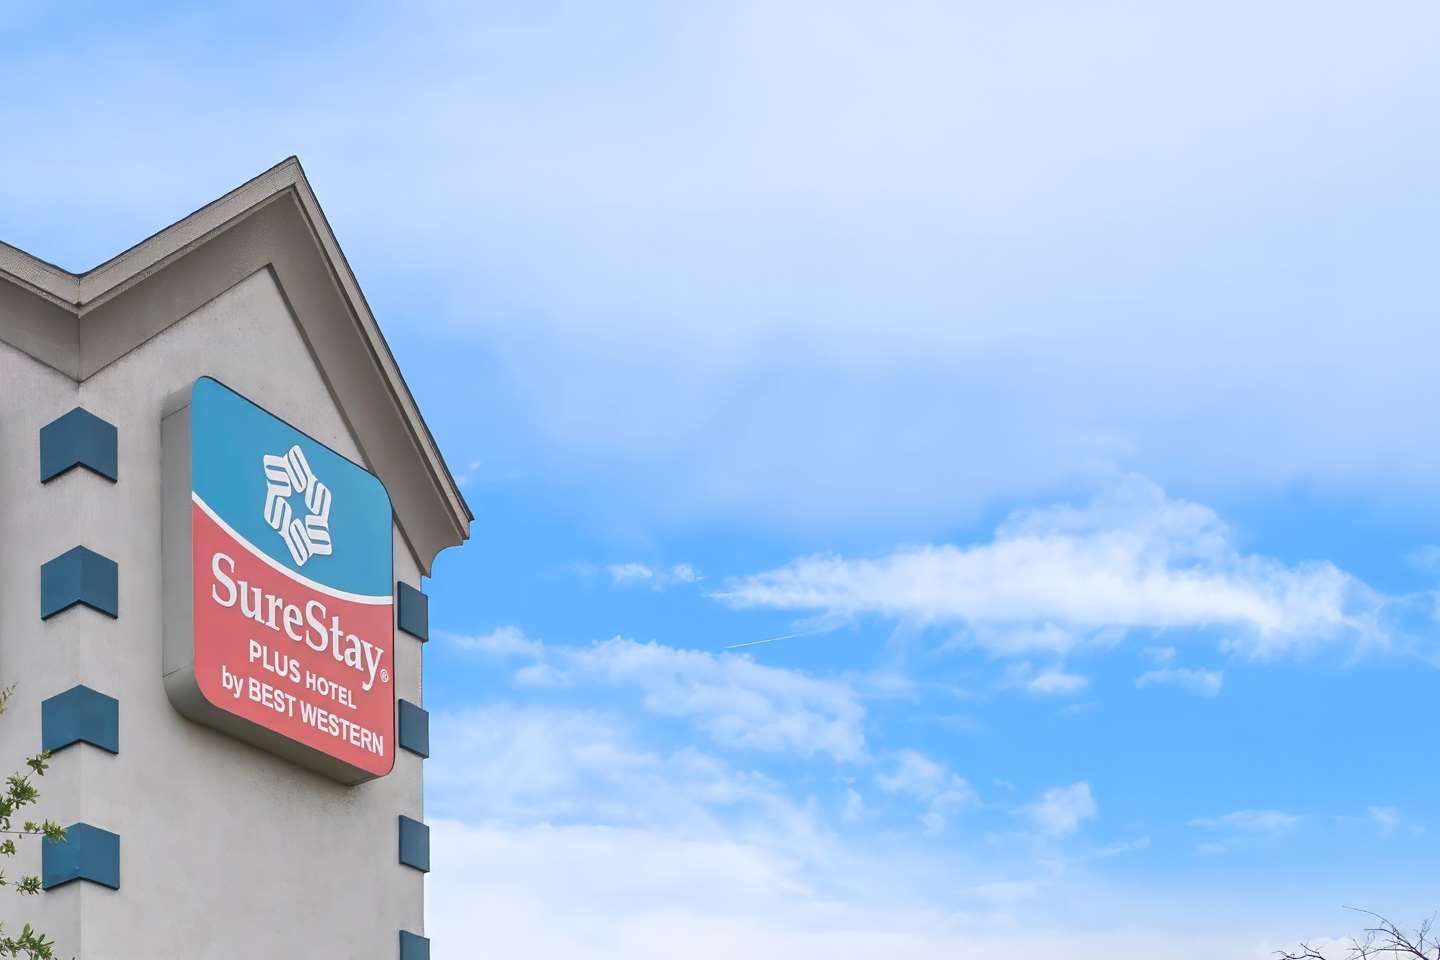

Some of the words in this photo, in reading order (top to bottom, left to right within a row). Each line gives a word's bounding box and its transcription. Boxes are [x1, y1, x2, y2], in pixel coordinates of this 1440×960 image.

[221, 665, 244, 699] by
[248, 676, 296, 718] BEST
[300, 700, 384, 756] WESTERN
[249, 639, 301, 684] PLUS
[305, 670, 357, 709] HOTEL
